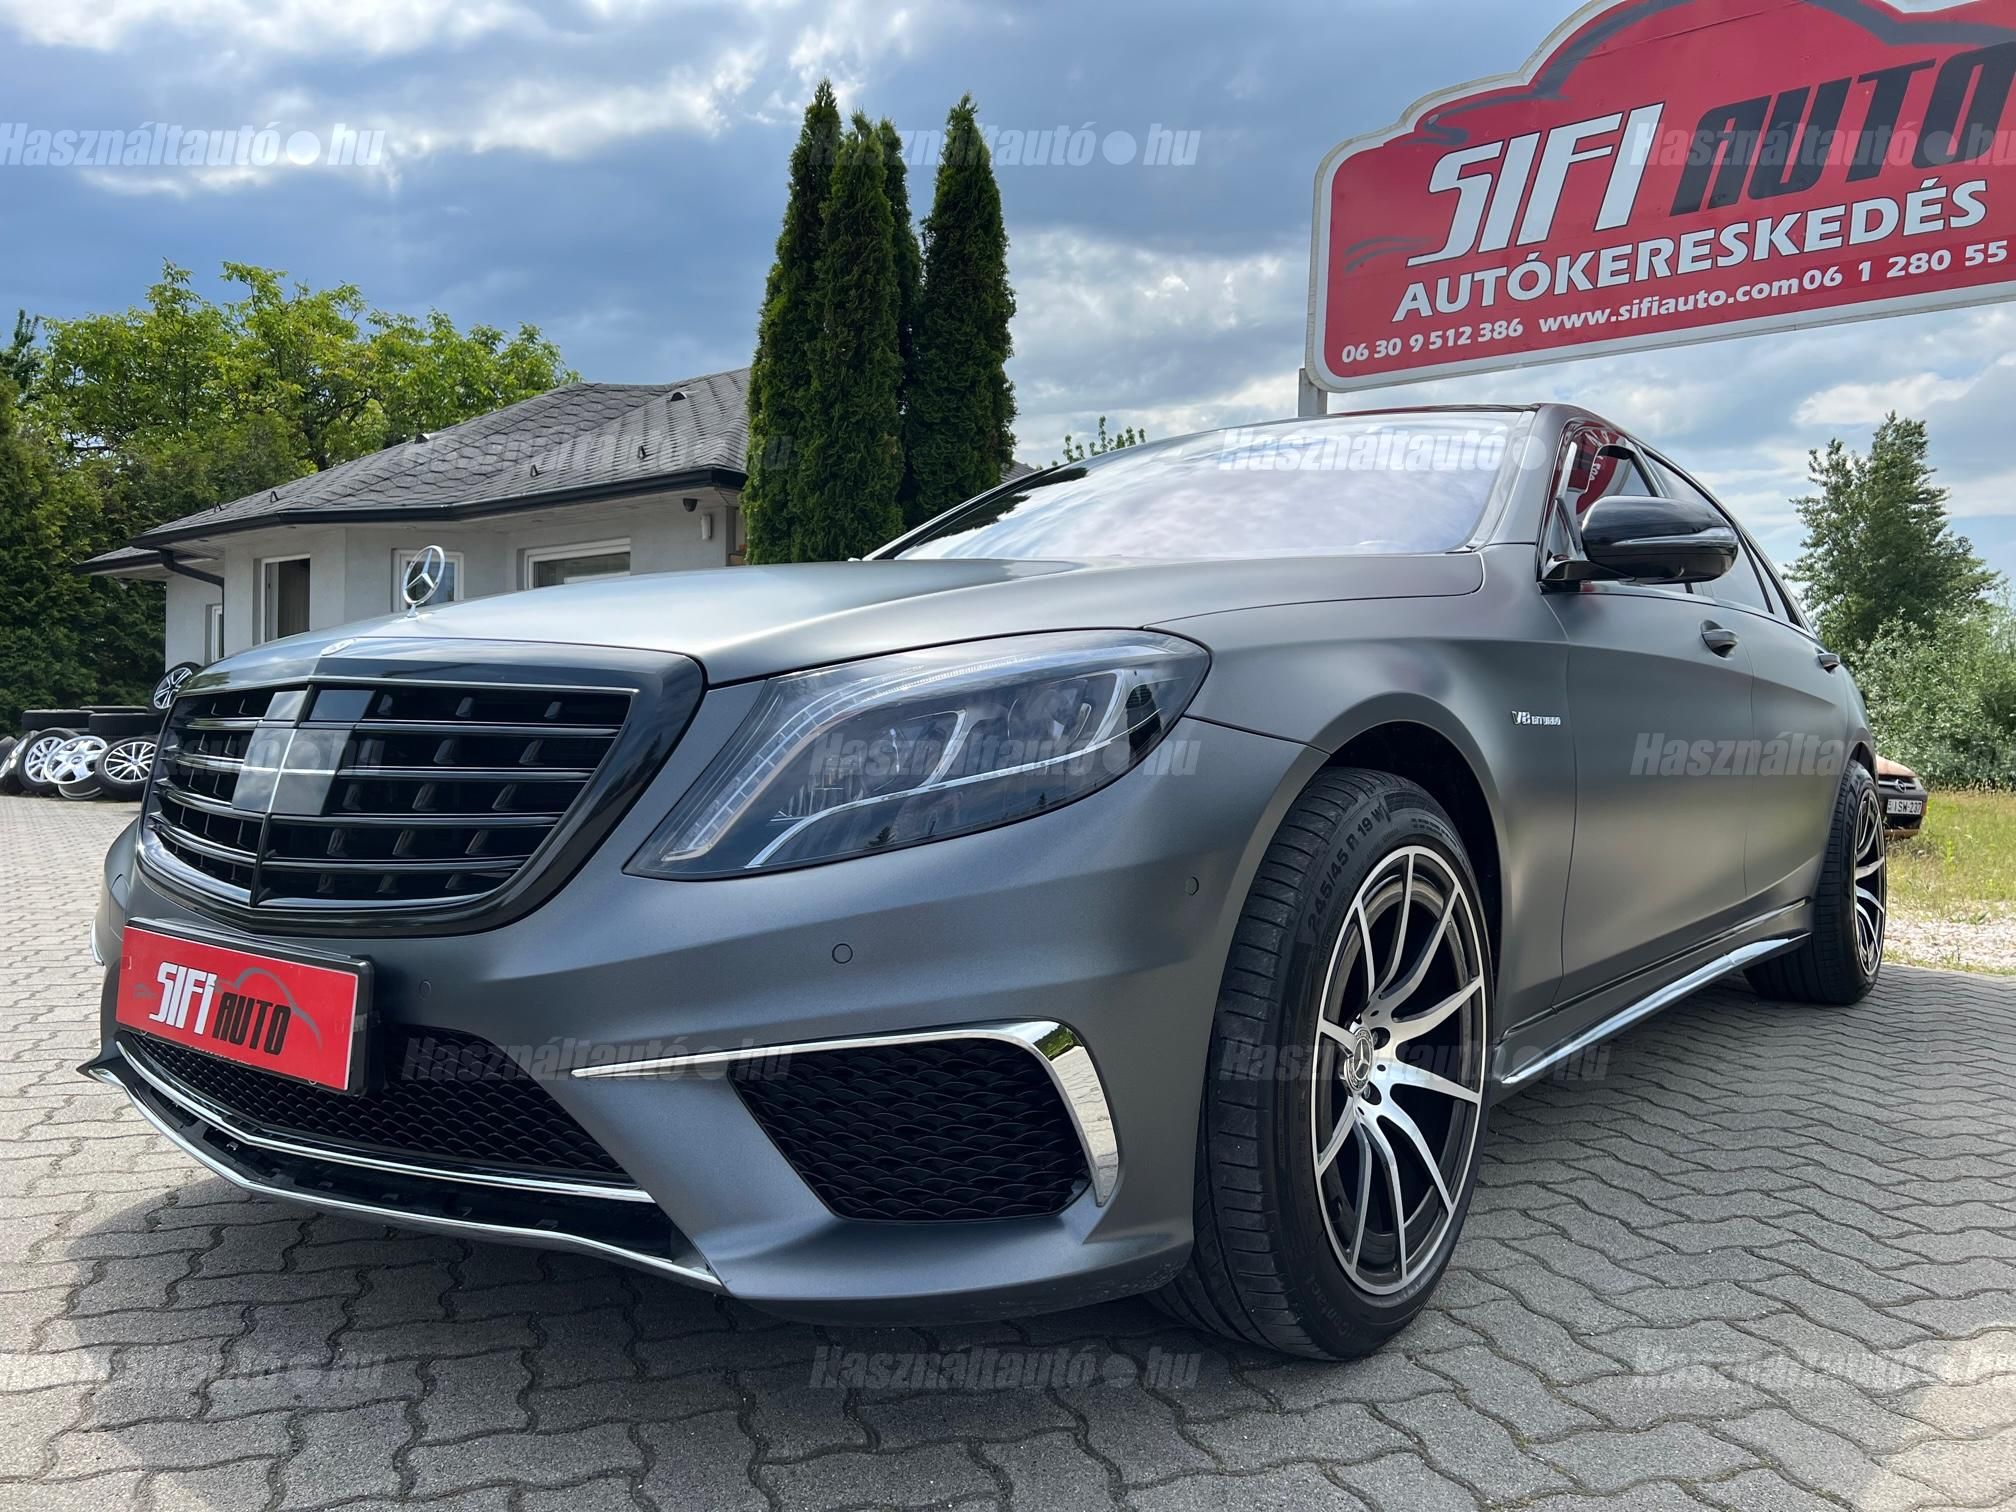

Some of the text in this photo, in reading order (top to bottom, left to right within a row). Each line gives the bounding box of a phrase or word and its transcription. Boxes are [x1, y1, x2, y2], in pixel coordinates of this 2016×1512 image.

[1406, 41, 2016, 267] SIFI AUTO
[1342, 240, 2008, 363] 06 30 9 512 386 www.sifiauto.com 06 1 280 55
[1392, 177, 1988, 322] AUTÓKERESKEDÉS
[1357, 816, 1373, 836] 19
[212, 992, 291, 1056] AUTO
